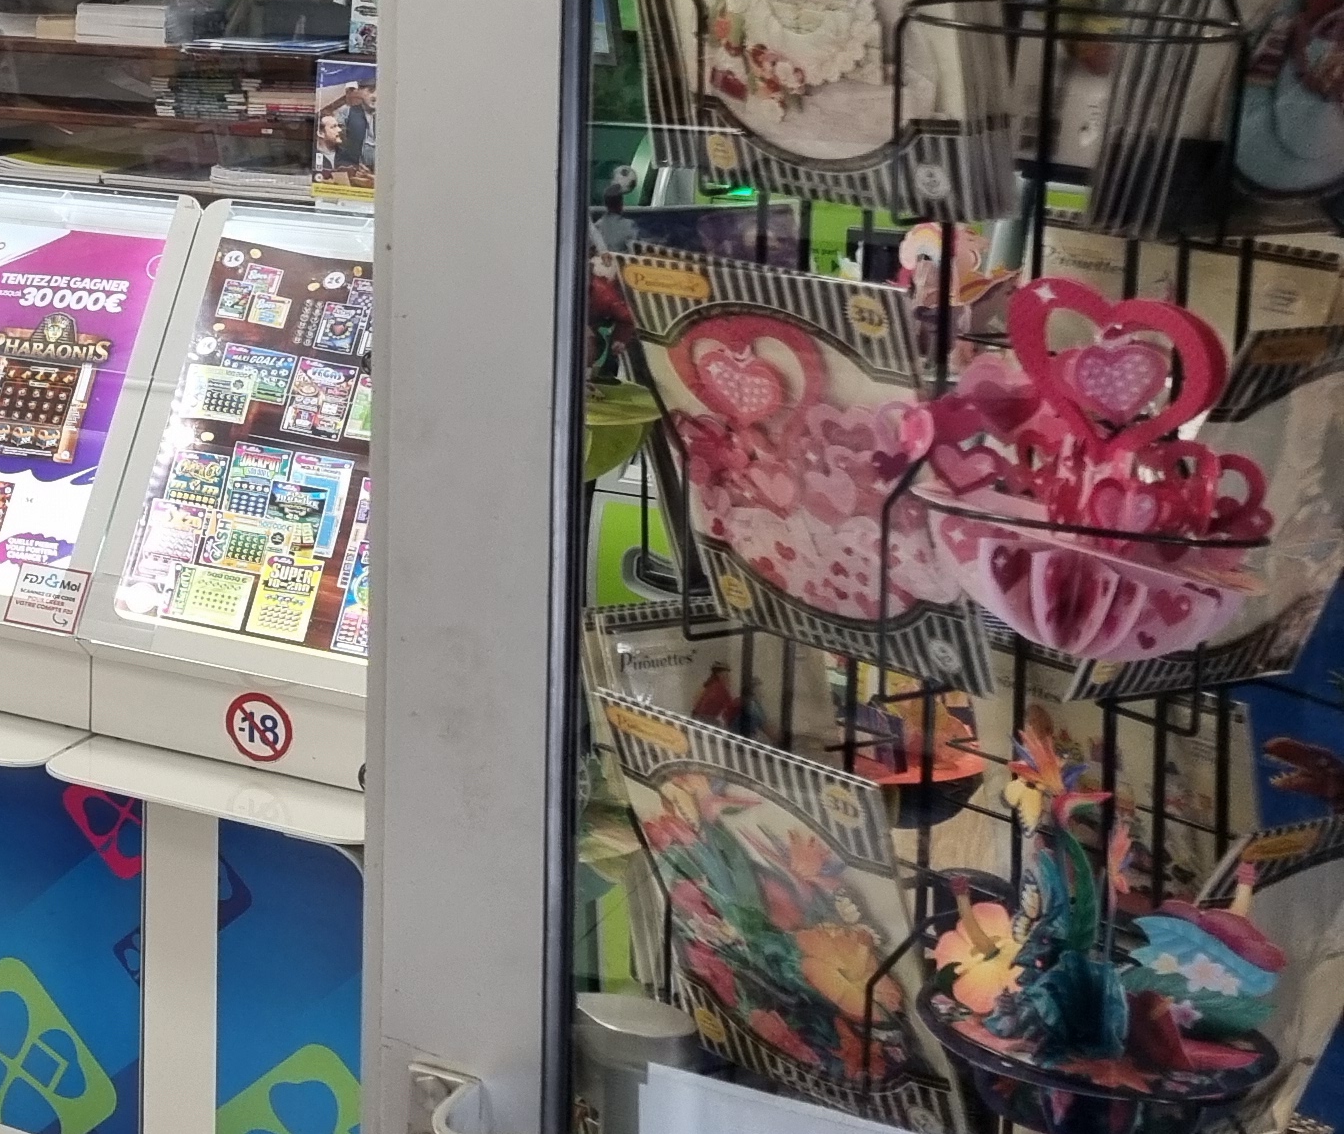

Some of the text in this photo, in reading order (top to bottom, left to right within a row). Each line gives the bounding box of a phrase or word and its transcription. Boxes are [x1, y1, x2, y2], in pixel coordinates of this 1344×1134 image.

[0, 272, 129, 292] TENTEZ DE GAGNER
